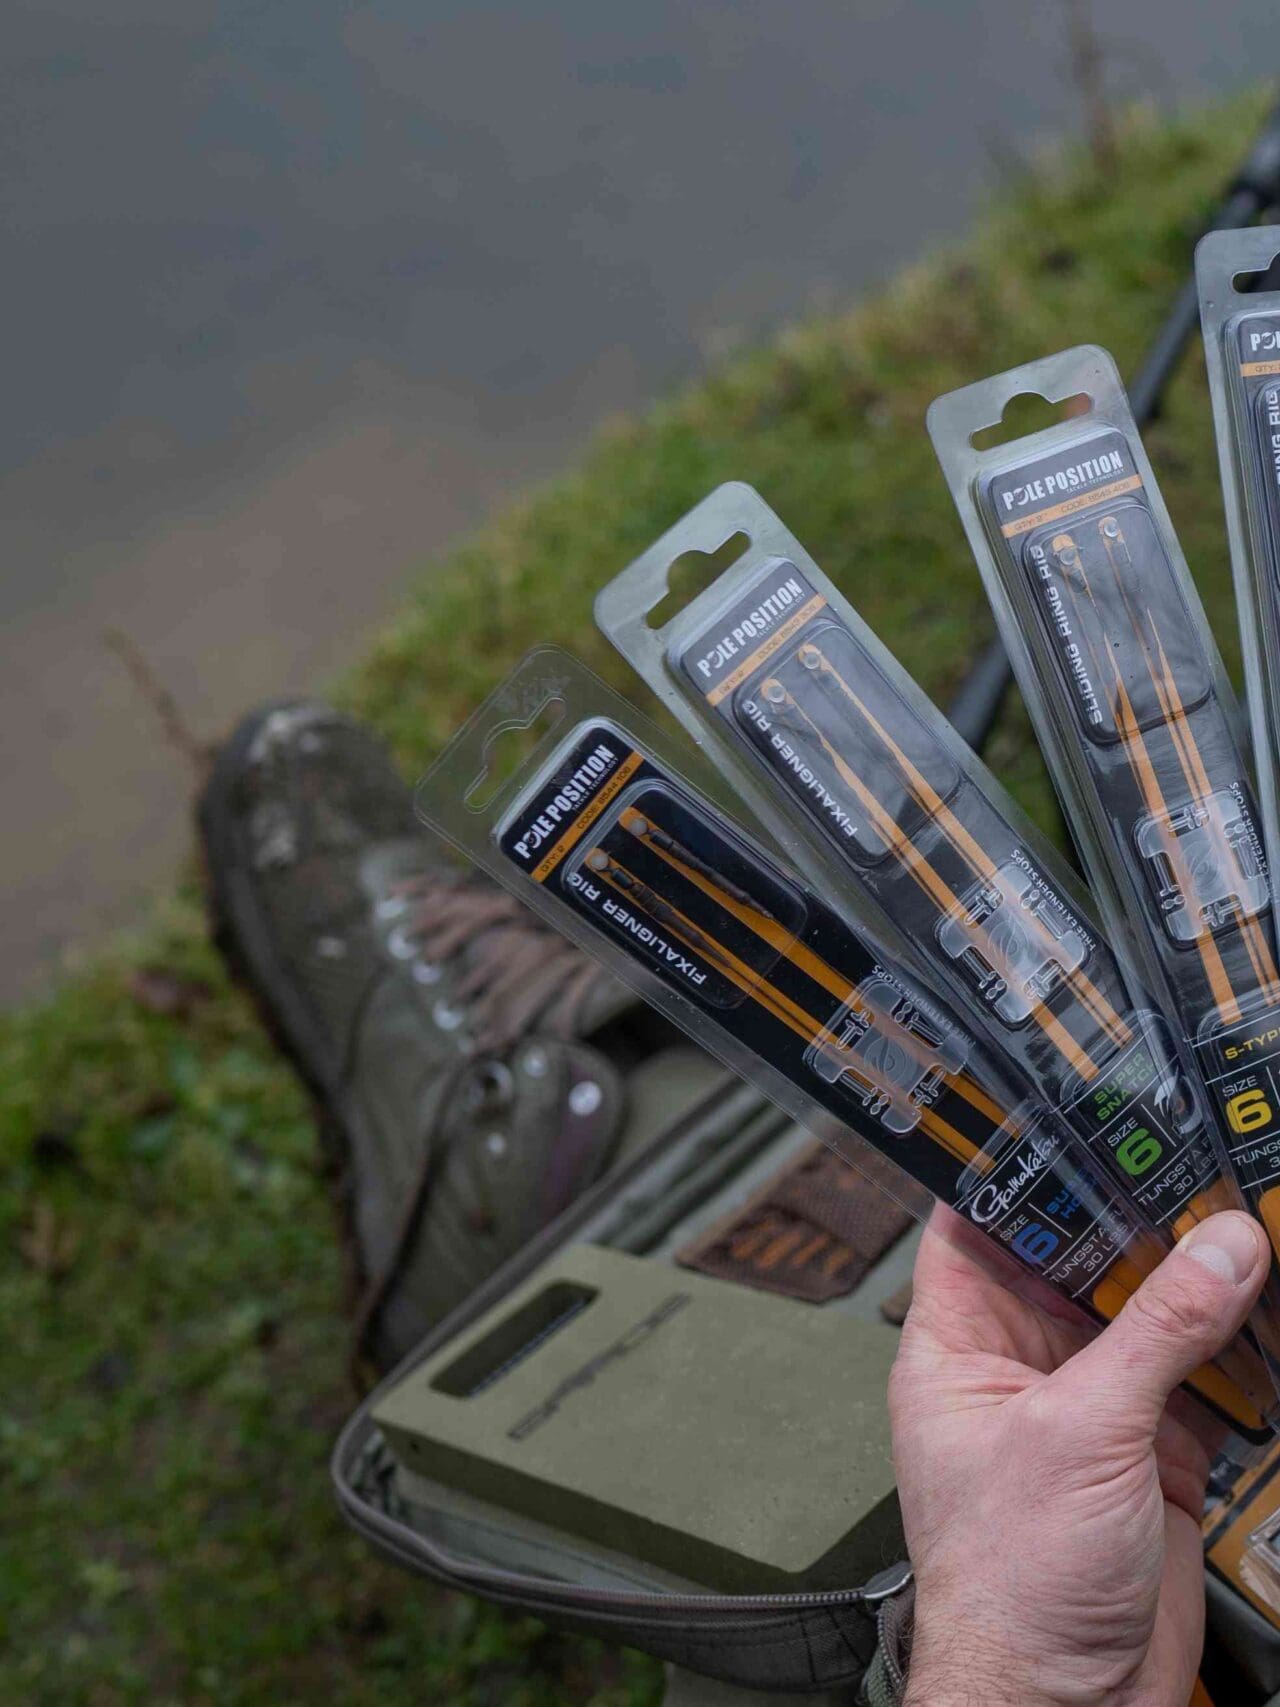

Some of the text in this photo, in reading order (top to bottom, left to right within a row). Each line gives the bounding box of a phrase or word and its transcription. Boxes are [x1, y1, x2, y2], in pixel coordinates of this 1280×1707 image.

[1002, 450, 1124, 510] POLE POSITION
[697, 577, 804, 678] POLE POSITION
[1030, 545, 1104, 725] SLIDING RING RIG
[742, 700, 858, 836] FIXALIGNER RIG
[513, 744, 616, 859] POLE POSITION
[575, 803, 600, 830] CODE:
[1009, 847, 1039, 882] STOPS
[1034, 877, 1078, 928] EXTENDER
[566, 872, 707, 985] FIXALIGNER RIG
[1094, 1052, 1145, 1105] SUPER
[1222, 1075, 1258, 1097] SIZE
[1107, 1116, 1138, 1147] SIZE
[1226, 1089, 1272, 1134] 6
[1116, 1127, 1163, 1176] 6
[1138, 1149, 1203, 1205] TUNGSTA
[1173, 1174, 1194, 1195] 30
[1000, 1214, 1029, 1242] SIZE
[1011, 1223, 1059, 1264] 6
[1051, 1226, 1107, 1283] TUNGSTA
[1083, 1252, 1103, 1272] 30
